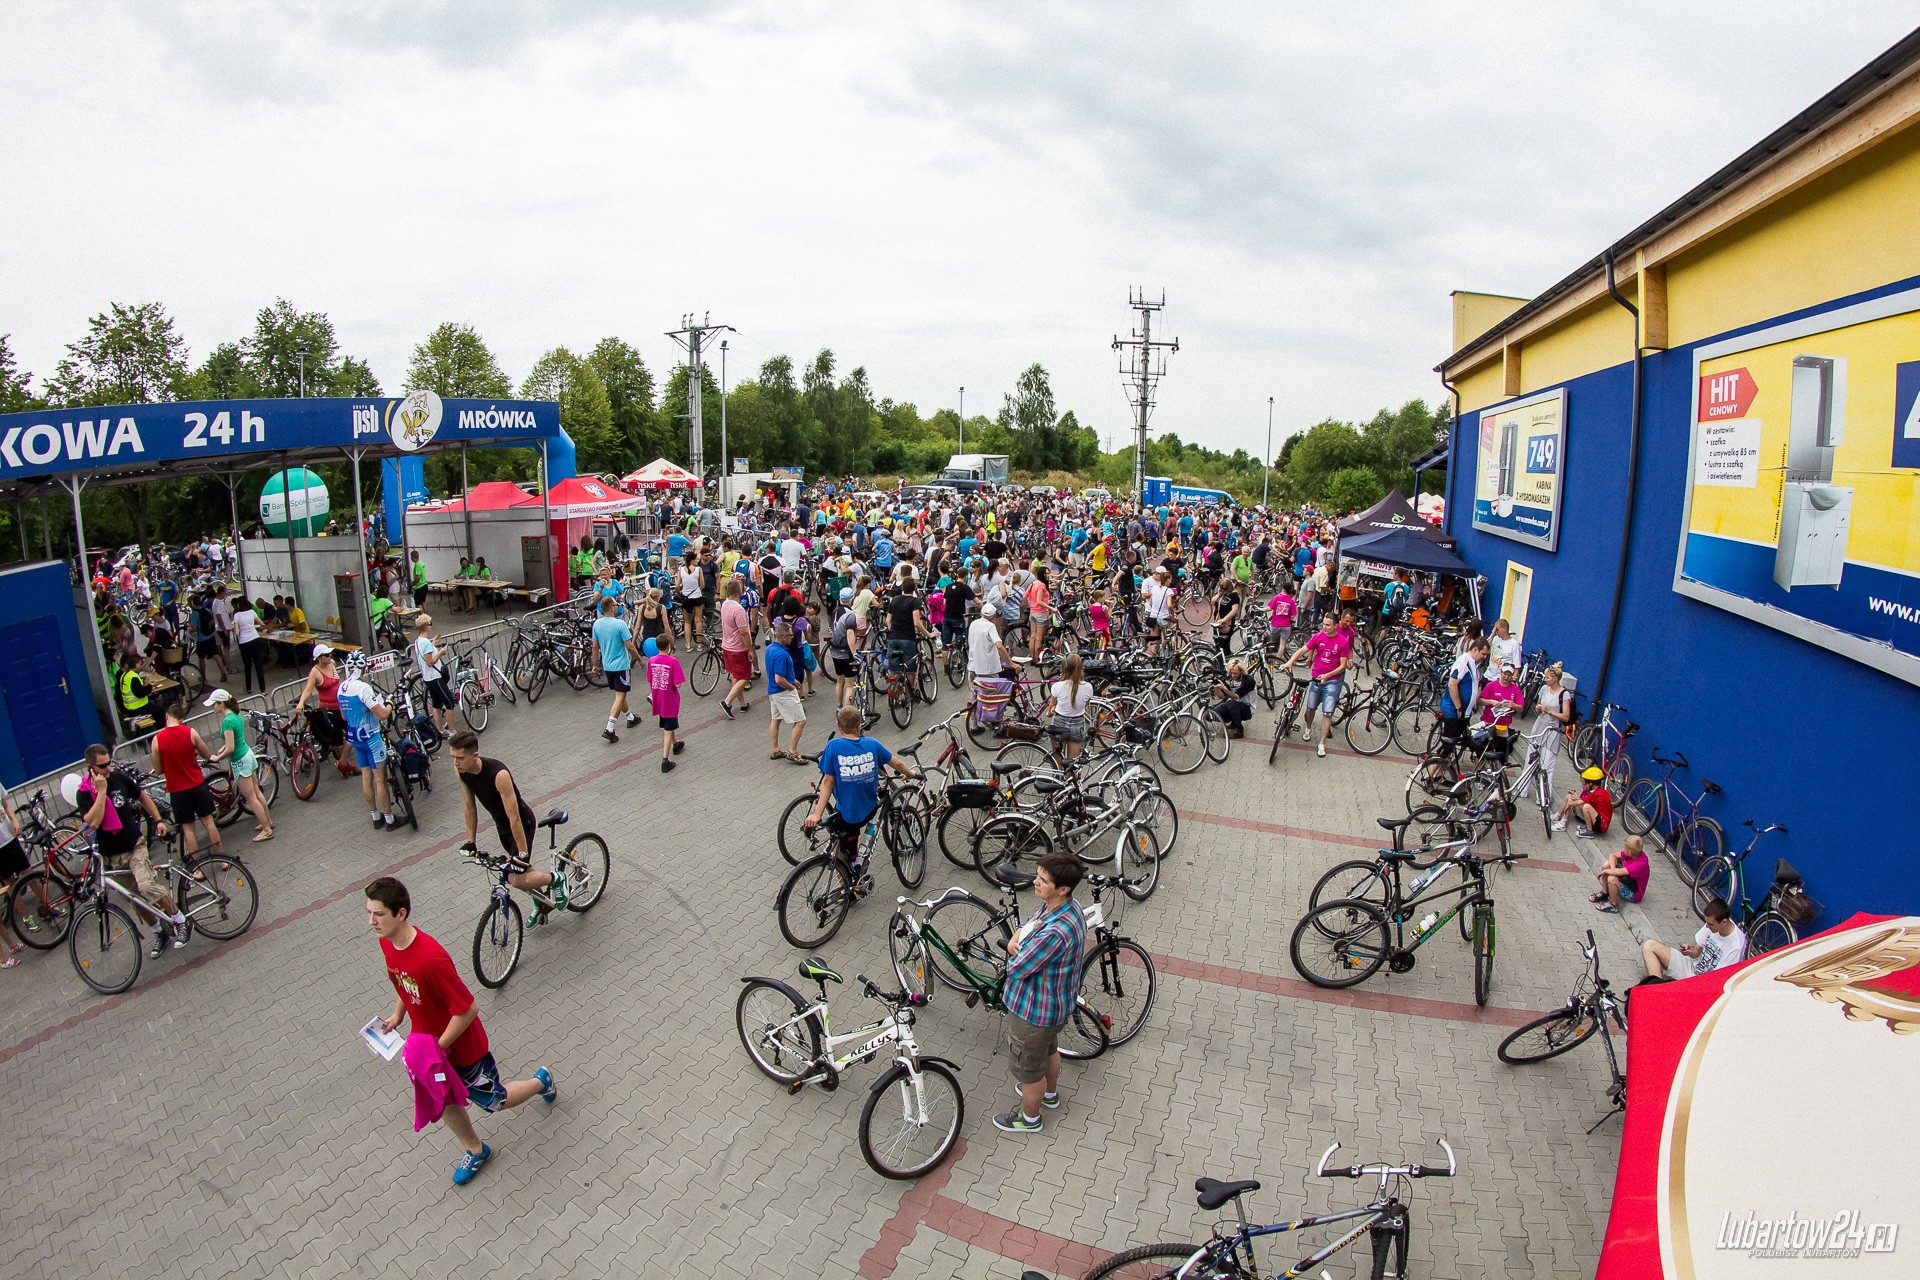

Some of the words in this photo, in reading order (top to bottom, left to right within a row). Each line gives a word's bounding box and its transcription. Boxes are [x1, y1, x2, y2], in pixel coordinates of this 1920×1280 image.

[1711, 373, 1739, 404] HIT
[1709, 403, 1738, 416] CENOWY
[353, 405, 379, 438] psb
[458, 405, 537, 429] MRÓWKA
[1710, 437, 1726, 446] szafka
[1740, 448, 1747, 456] 85
[1726, 460, 1744, 470] szafką
[1710, 471, 1742, 480] oświetleniem
[669, 481, 688, 489] TYSKIE
[1536, 480, 1552, 490] KABINA
[1364, 561, 1392, 570] SERWIS
[837, 752, 874, 766] beans
[840, 761, 875, 777] SMURF
